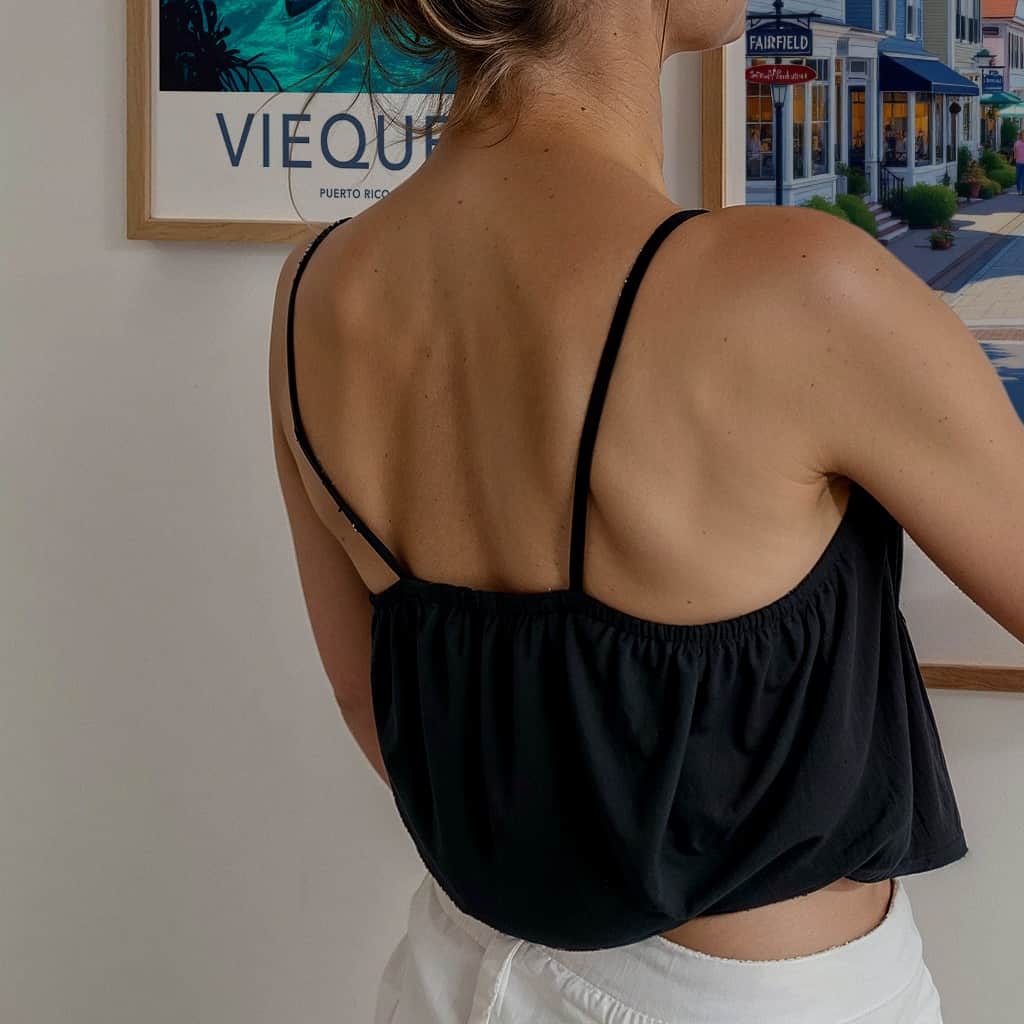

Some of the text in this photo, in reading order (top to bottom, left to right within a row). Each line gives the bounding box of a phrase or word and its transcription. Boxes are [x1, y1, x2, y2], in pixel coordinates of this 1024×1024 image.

[750, 35, 809, 50] FAIRFIELD
[319, 188, 390, 200] PUERTO RICO
